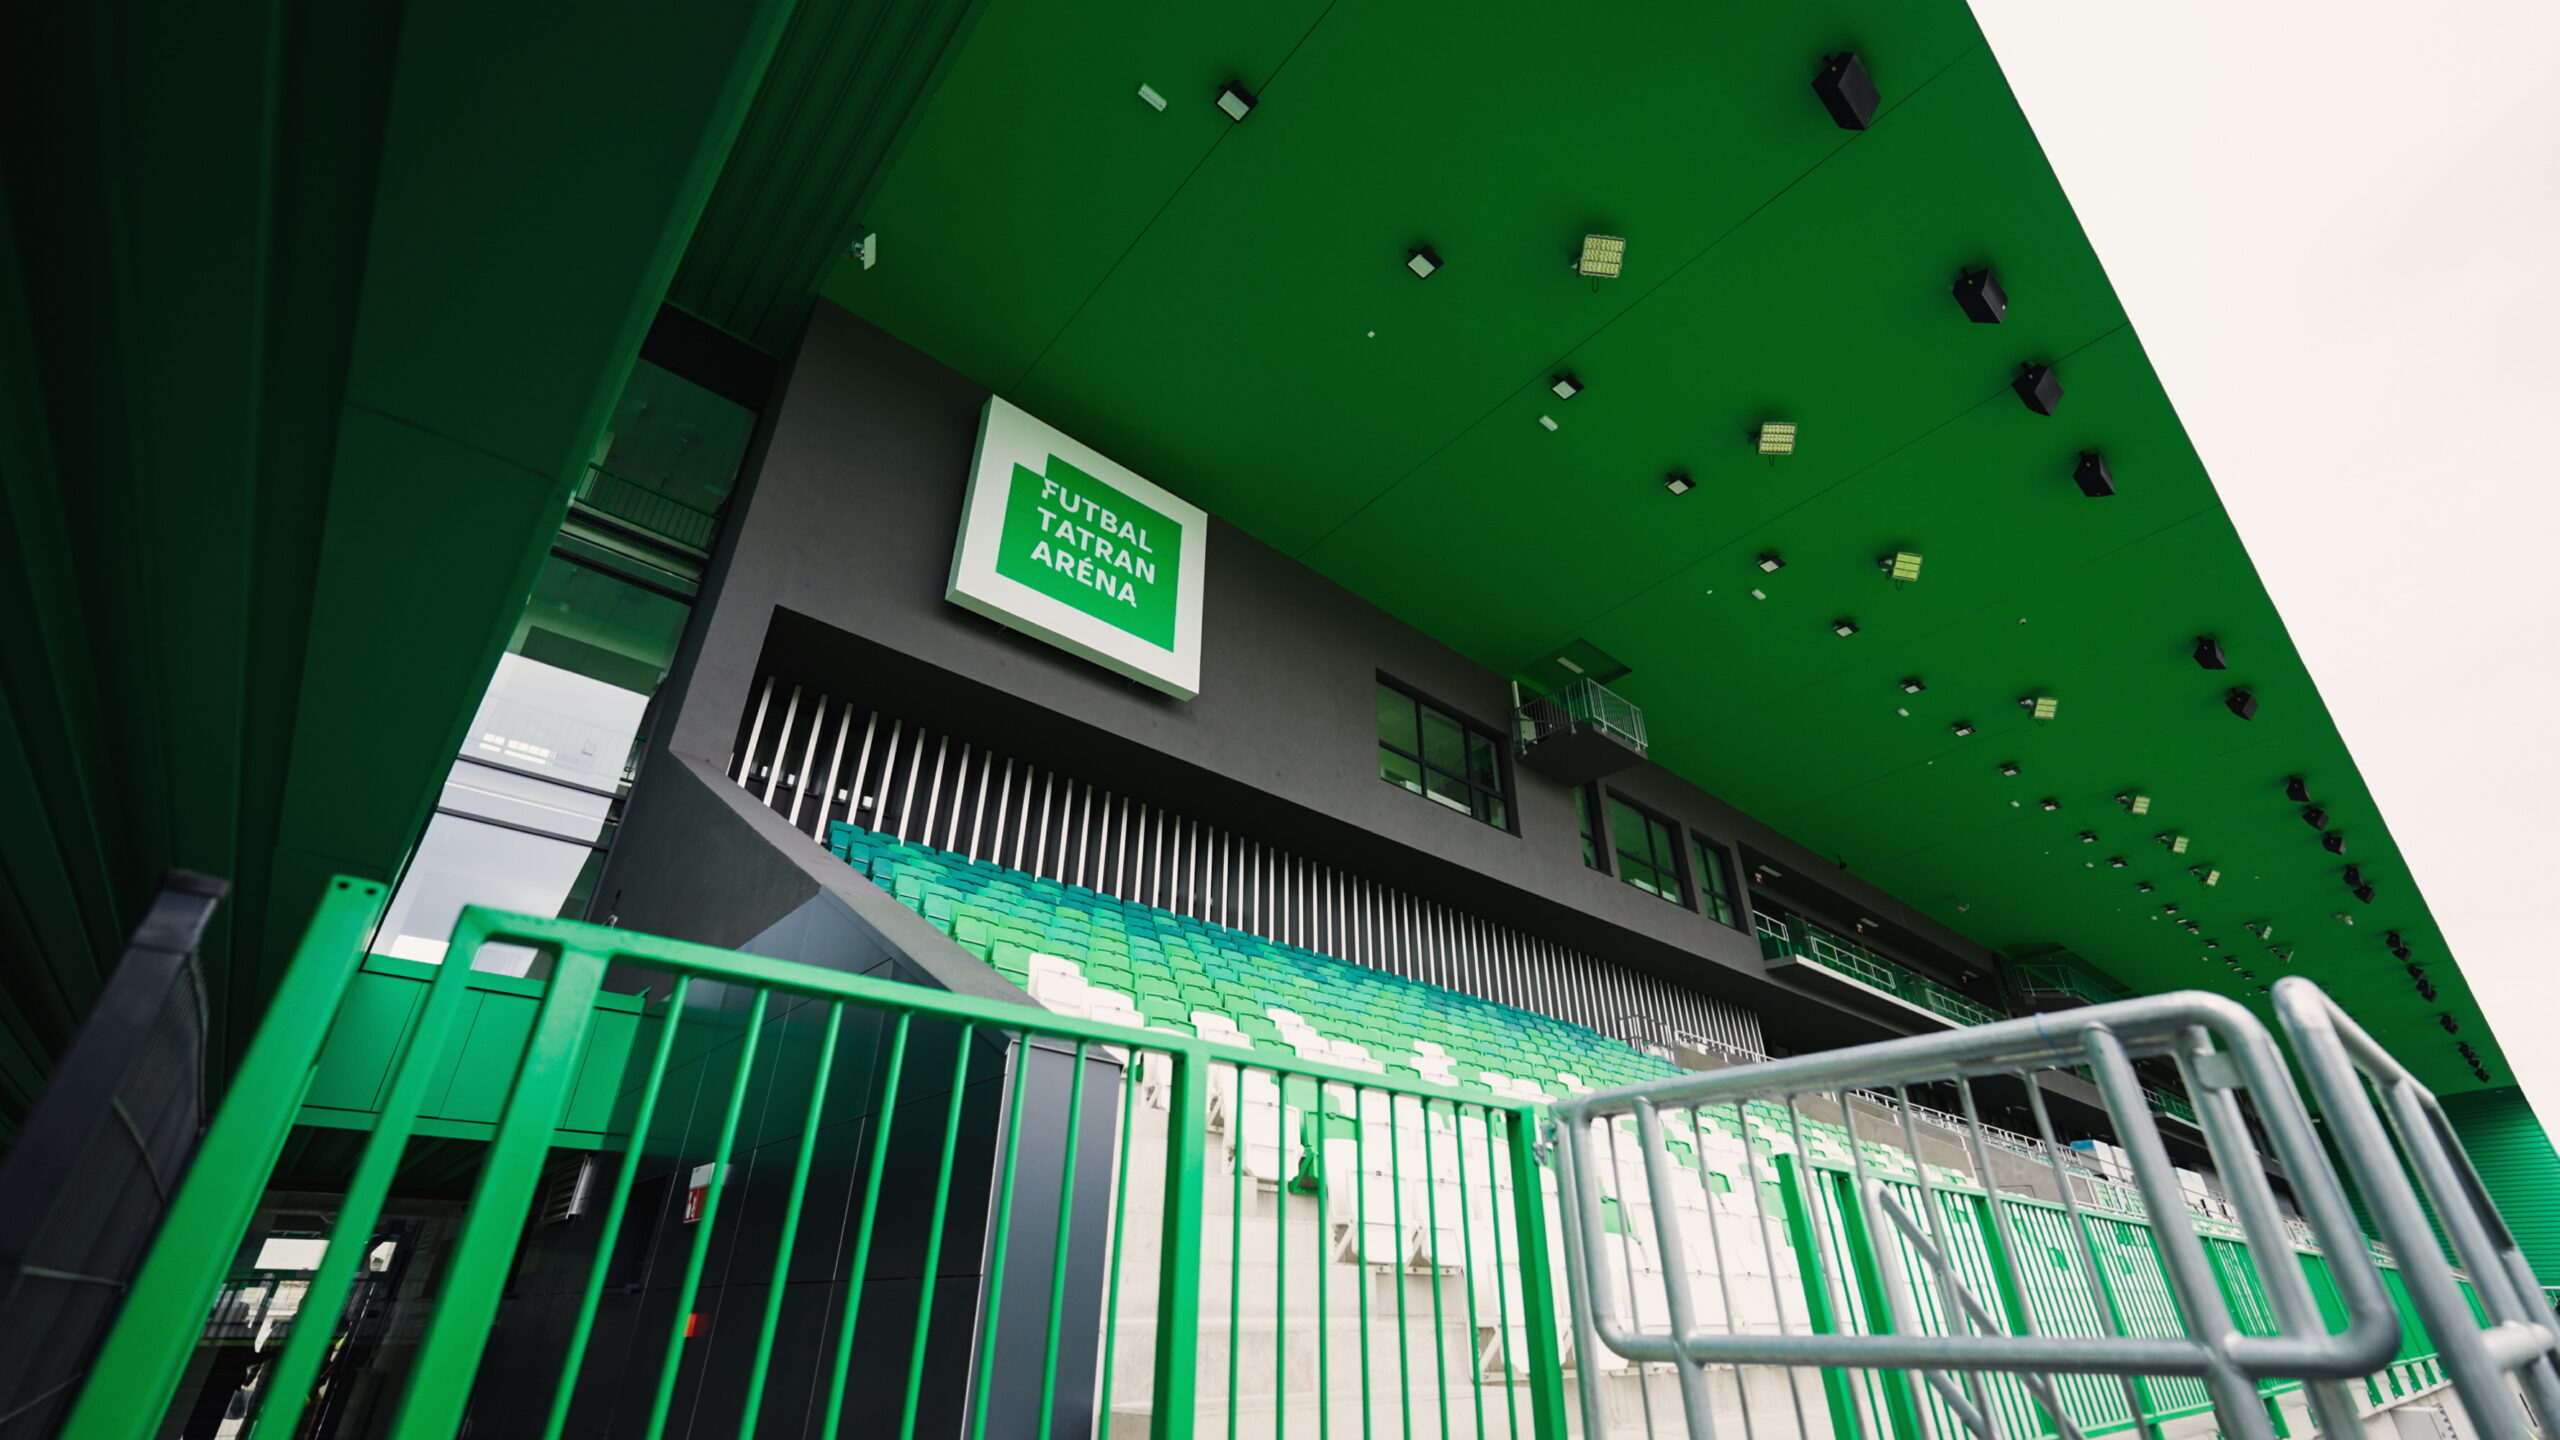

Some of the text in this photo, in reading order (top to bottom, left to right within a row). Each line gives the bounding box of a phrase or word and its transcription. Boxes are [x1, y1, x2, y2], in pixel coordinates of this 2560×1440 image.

[1037, 506, 1155, 584] TATRAN
[1041, 478, 1153, 553] FUTBAL
[1030, 541, 1137, 608] ARÉNA
